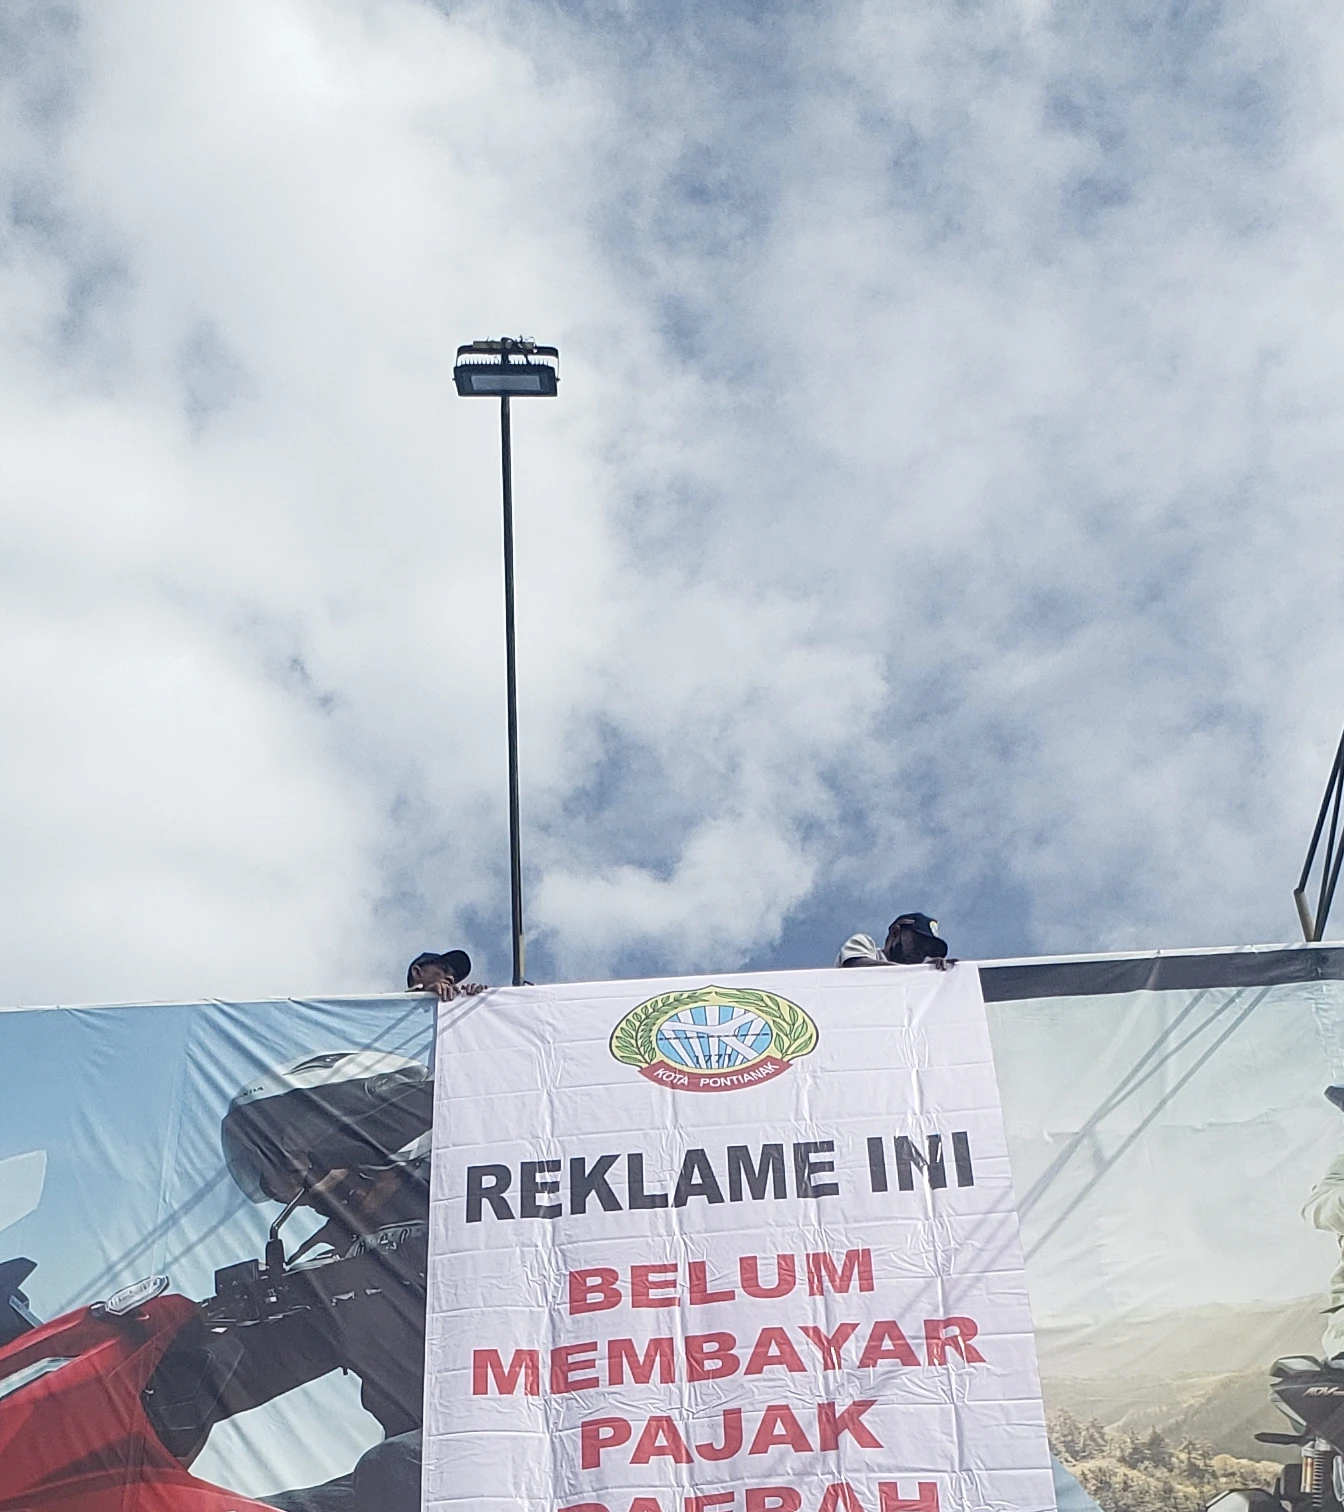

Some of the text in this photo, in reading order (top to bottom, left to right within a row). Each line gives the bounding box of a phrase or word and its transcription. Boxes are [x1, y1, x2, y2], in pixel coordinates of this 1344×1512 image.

[653, 1060, 780, 1088] KOTA PONTIANAK
[465, 1131, 975, 1224] REKLAME INI
[568, 1248, 876, 1316] BELUM
[471, 1315, 987, 1397] MEMBAYAR
[580, 1400, 884, 1471] PAJAK
